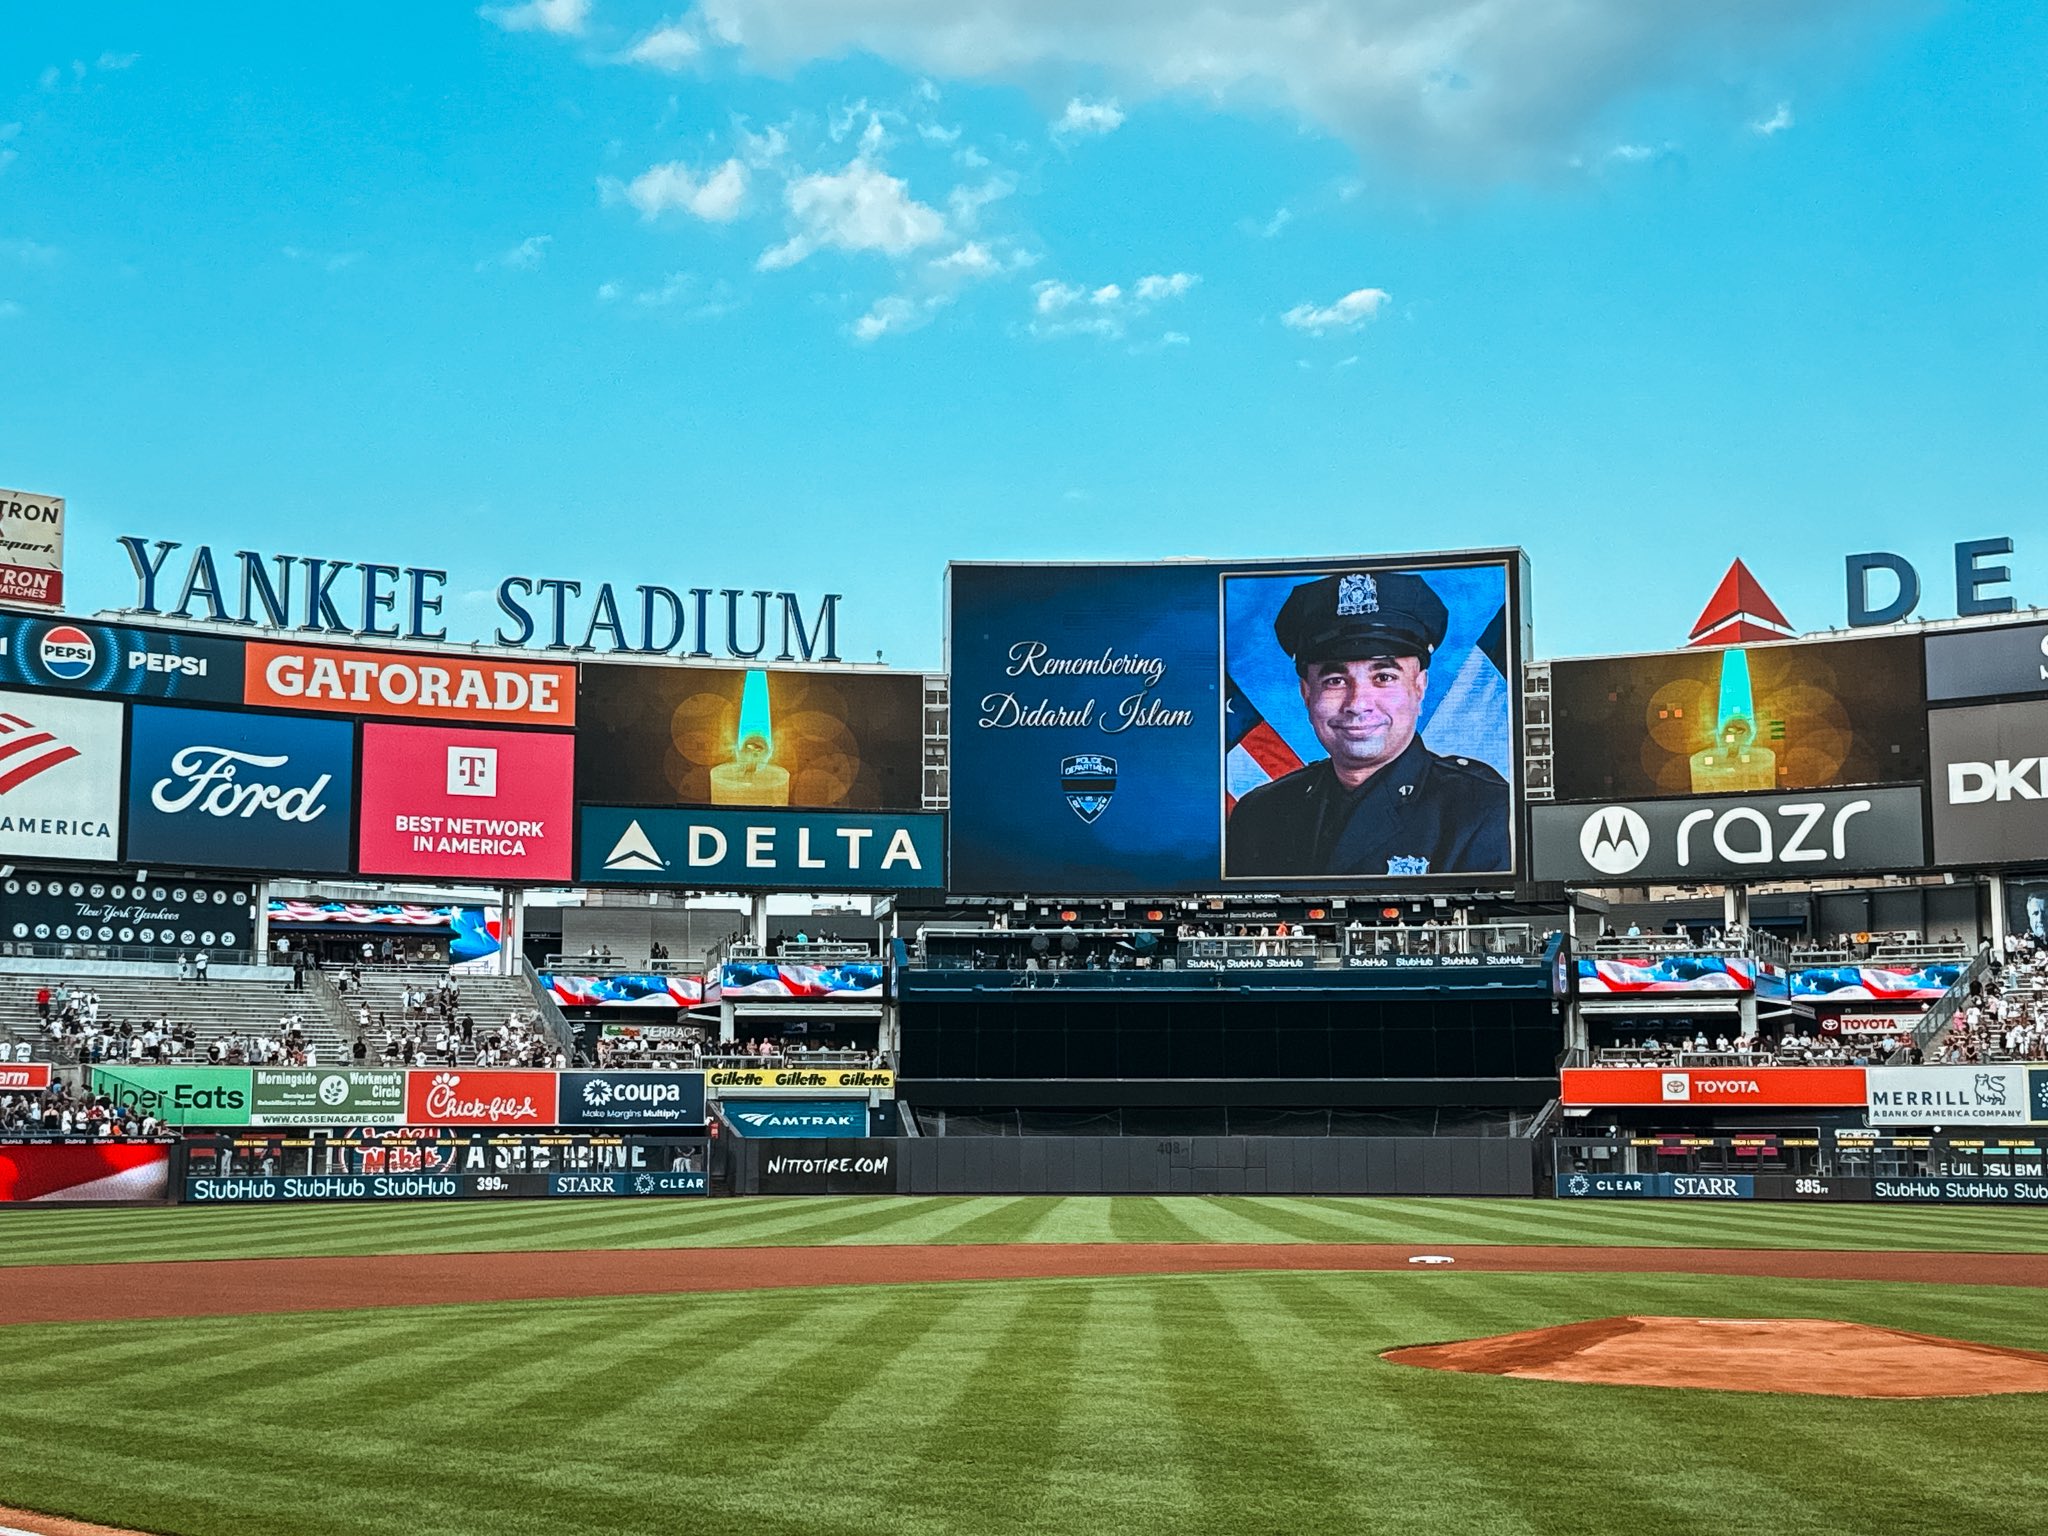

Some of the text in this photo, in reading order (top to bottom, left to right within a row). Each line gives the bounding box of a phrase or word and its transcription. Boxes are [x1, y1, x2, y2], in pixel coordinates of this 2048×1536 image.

[0, 584, 47, 599] ATCHES
[1845, 536, 2017, 628] DE
[116, 535, 843, 662] YANKEE STADIUM
[44, 645, 92, 661] PEPSI
[128, 651, 208, 677] PEPSI
[1006, 640, 1167, 687] Remembering
[265, 655, 561, 714] GATORADE
[978, 689, 1194, 733] Didarul Islam
[151, 746, 332, 822] Ford
[1398, 785, 1414, 796] 47
[0, 816, 111, 838] AMERICA
[395, 815, 545, 838] BEST NETWORK
[1677, 800, 1871, 867] razr
[413, 835, 527, 856] IN AMERICA
[688, 825, 922, 871] DELTA
[75, 902, 180, 925] New York Yankees
[1186, 959, 1304, 969] StubHu StubHub StubHub
[1349, 955, 1524, 967] StubHub StubHub StubHub StubHub
[1841, 1019, 1897, 1030] TOYOTA
[257, 1071, 318, 1087] Morningside
[350, 1072, 402, 1085] Workmen's
[710, 1071, 890, 1086] Gillette Gillette Gillette
[1694, 1080, 1760, 1093] TOYOTA
[174, 1084, 244, 1110] Eats
[372, 1085, 401, 1098] Circle
[425, 1073, 538, 1122] Chick-fil-A
[613, 1083, 680, 1107] coupa
[1873, 1091, 1970, 1105] MERRILL
[262, 1115, 396, 1124] WWW.CASSENACARE.COM
[582, 1109, 605, 1118] Make
[607, 1109, 641, 1119] Margins
[768, 1116, 851, 1126] AMTRAK
[767, 1155, 889, 1176] NITTOTIRE.COM
[194, 1177, 456, 1200] StubHub StubHub StubHub
[556, 1176, 616, 1193] STARR
[660, 1179, 704, 1189] CLEAR
[1596, 1181, 1642, 1191] CLEAR
[1674, 1177, 1739, 1196] STARR
[1875, 1181, 2048, 1200] StubHub StubHub Stub
